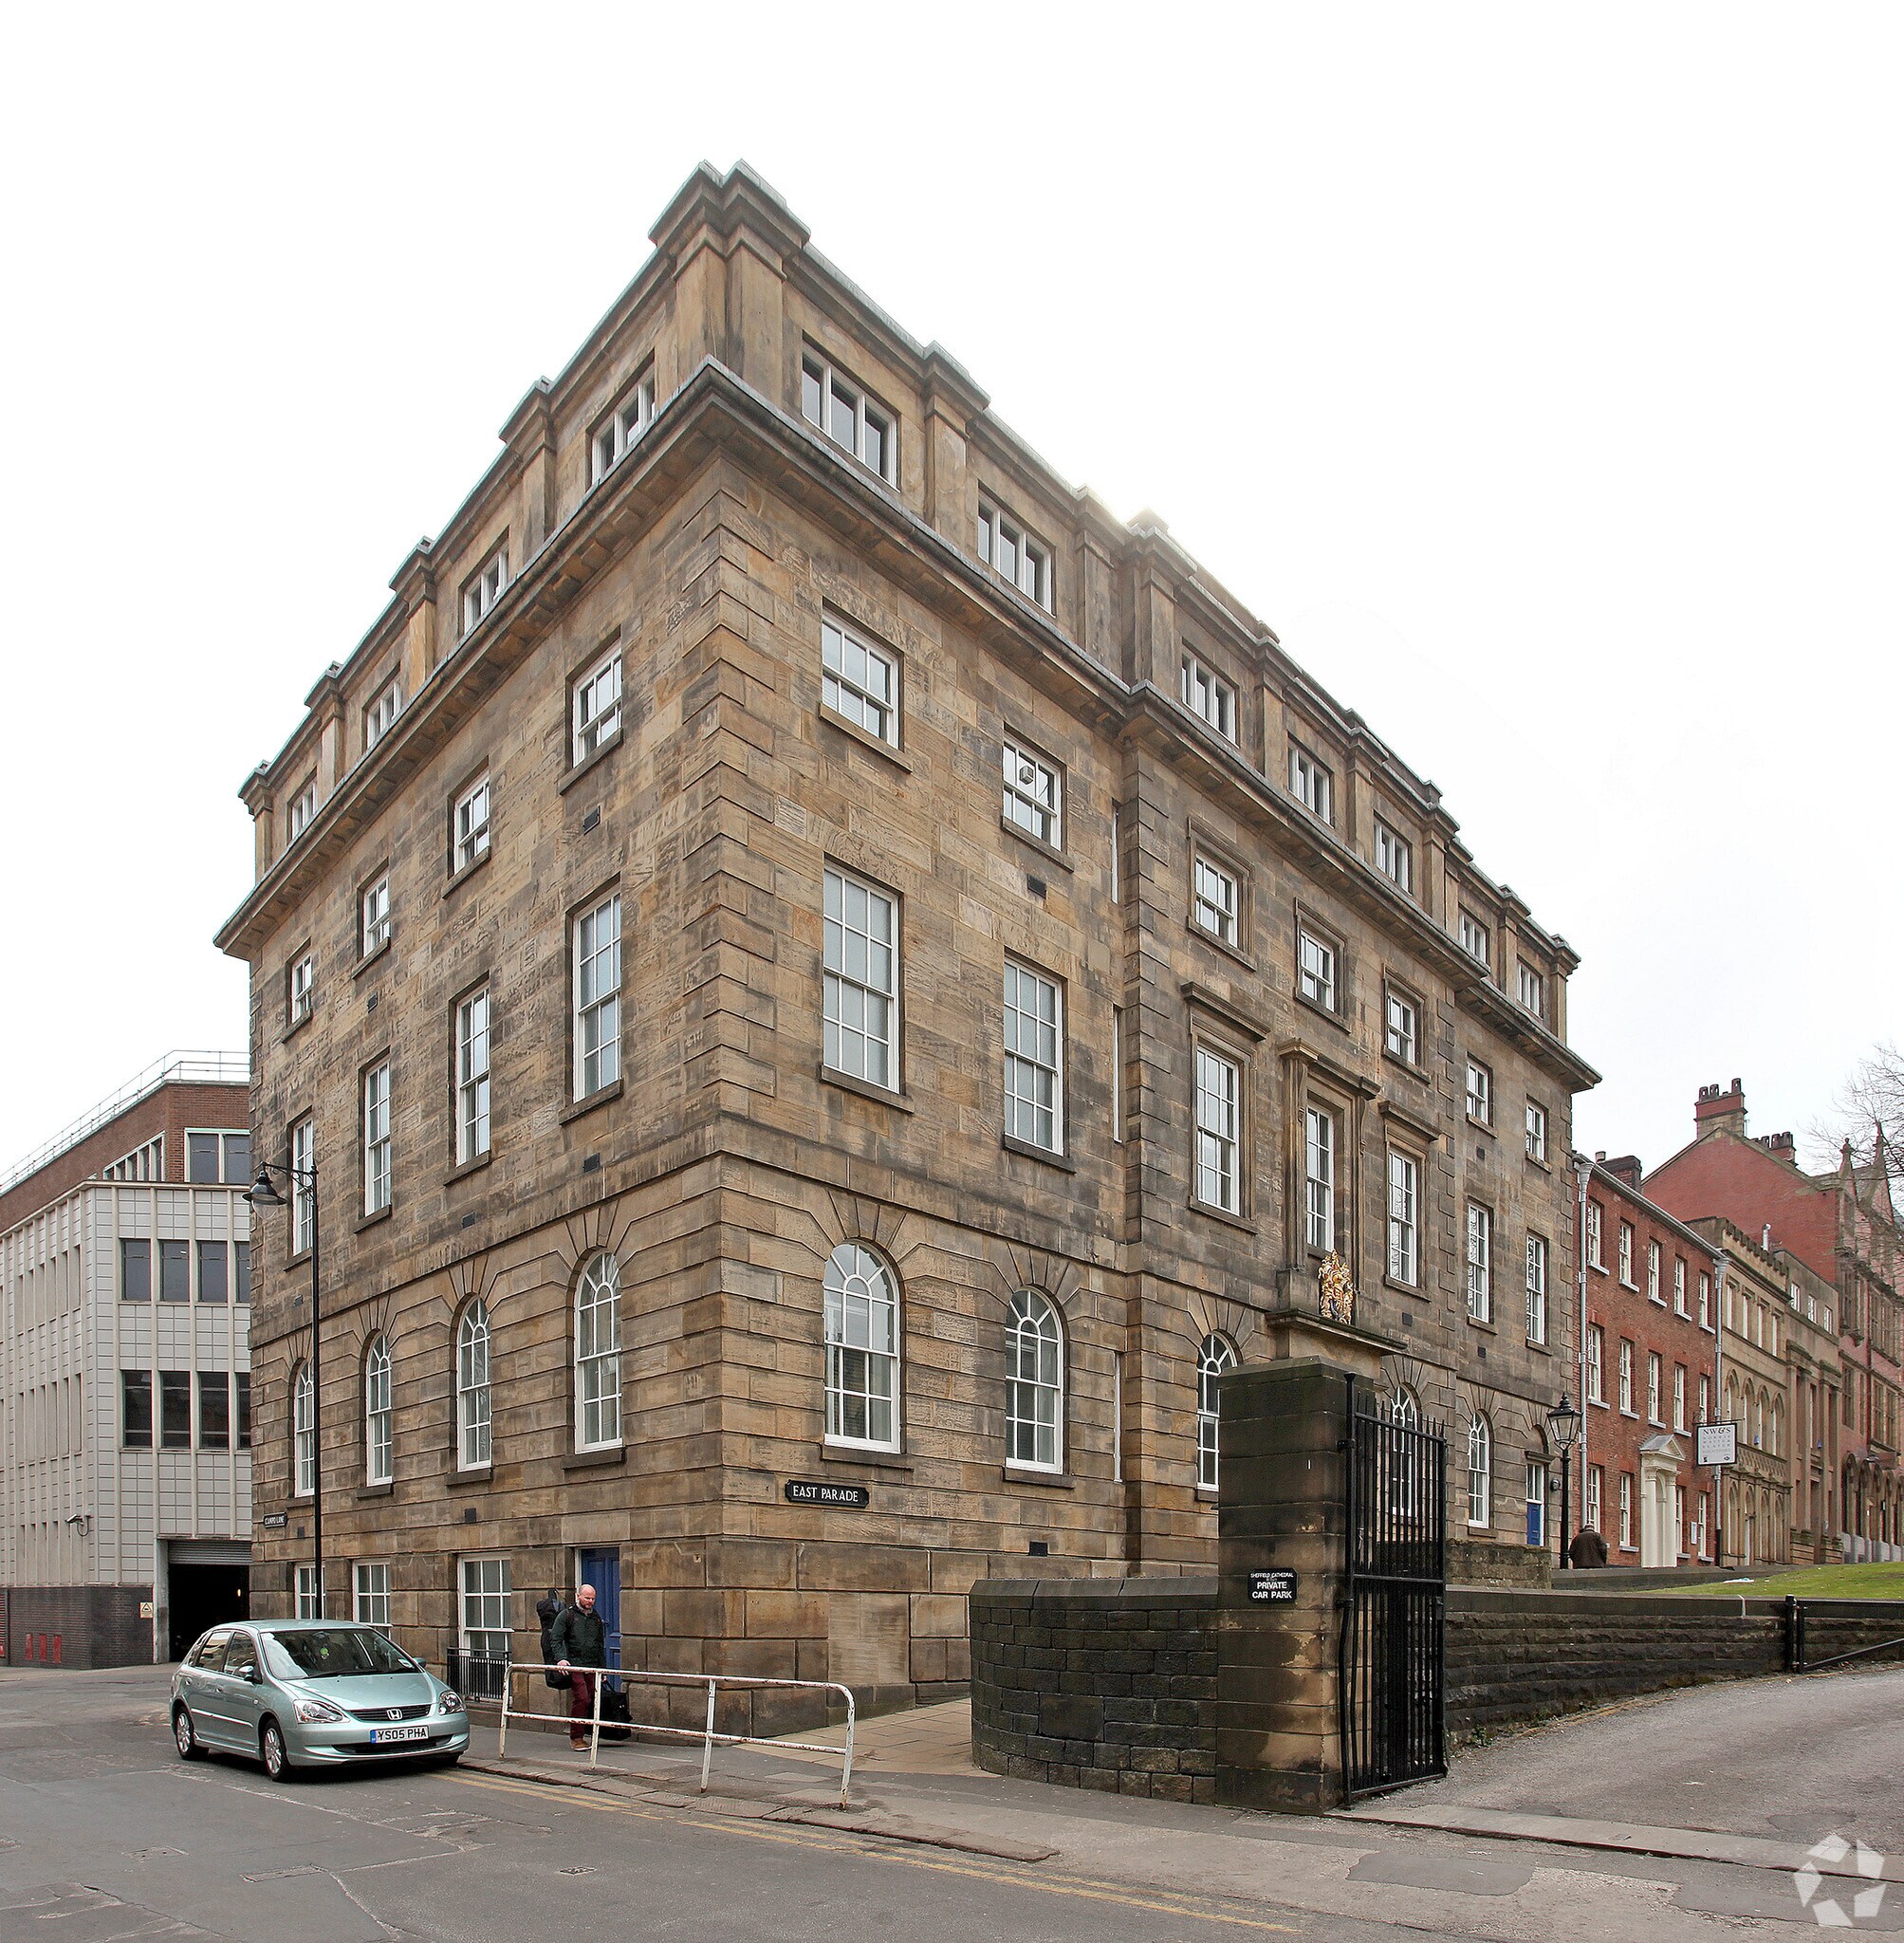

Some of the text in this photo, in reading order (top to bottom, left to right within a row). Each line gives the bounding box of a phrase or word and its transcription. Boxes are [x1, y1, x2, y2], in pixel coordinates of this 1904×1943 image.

[793, 1485, 859, 1502] EAST PARADE
[1257, 1581, 1287, 1589] PRIVATE
[378, 1728, 426, 1740] YS05 PHA
